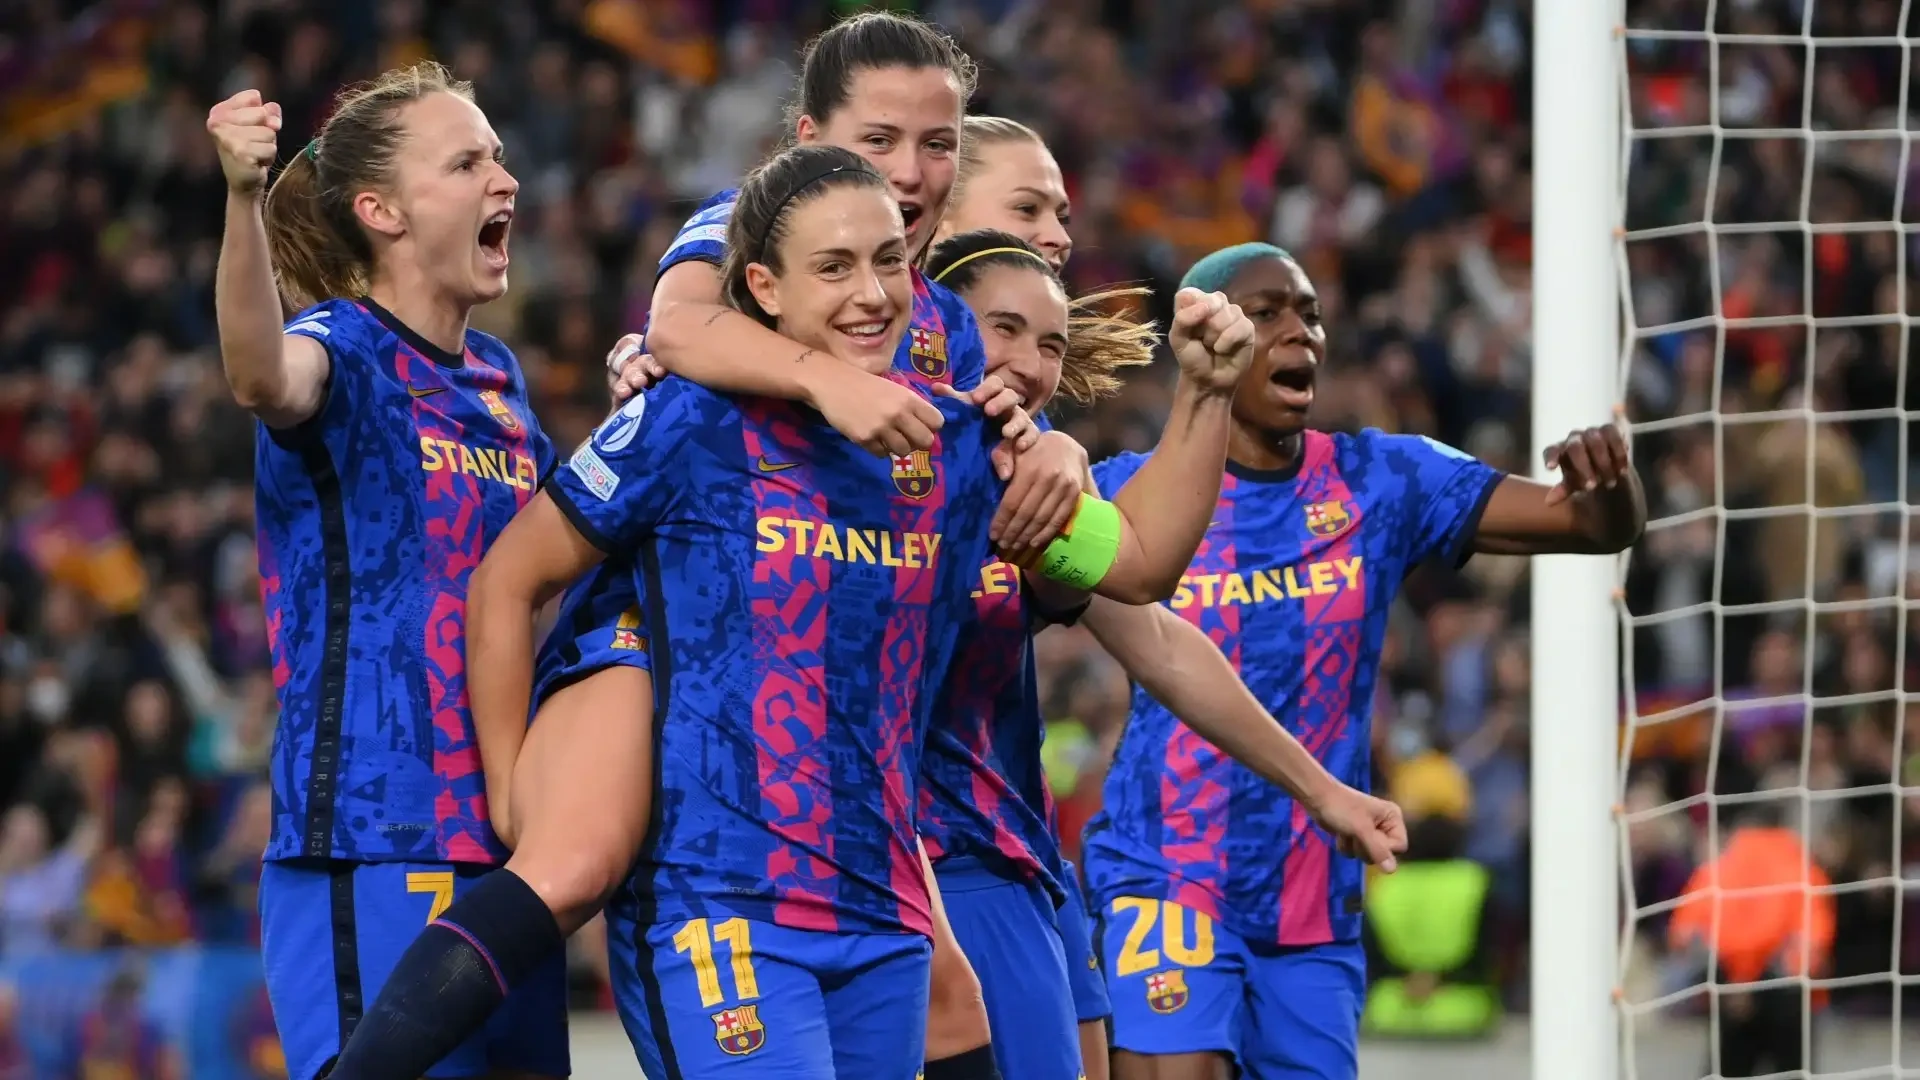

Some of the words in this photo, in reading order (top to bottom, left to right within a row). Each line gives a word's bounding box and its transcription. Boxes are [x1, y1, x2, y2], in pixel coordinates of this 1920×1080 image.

[756, 516, 943, 569] STANLEY
[1170, 556, 1364, 609] STANLEY
[405, 872, 454, 927] 7
[672, 917, 760, 1008] 11
[1111, 896, 1215, 977] 20
